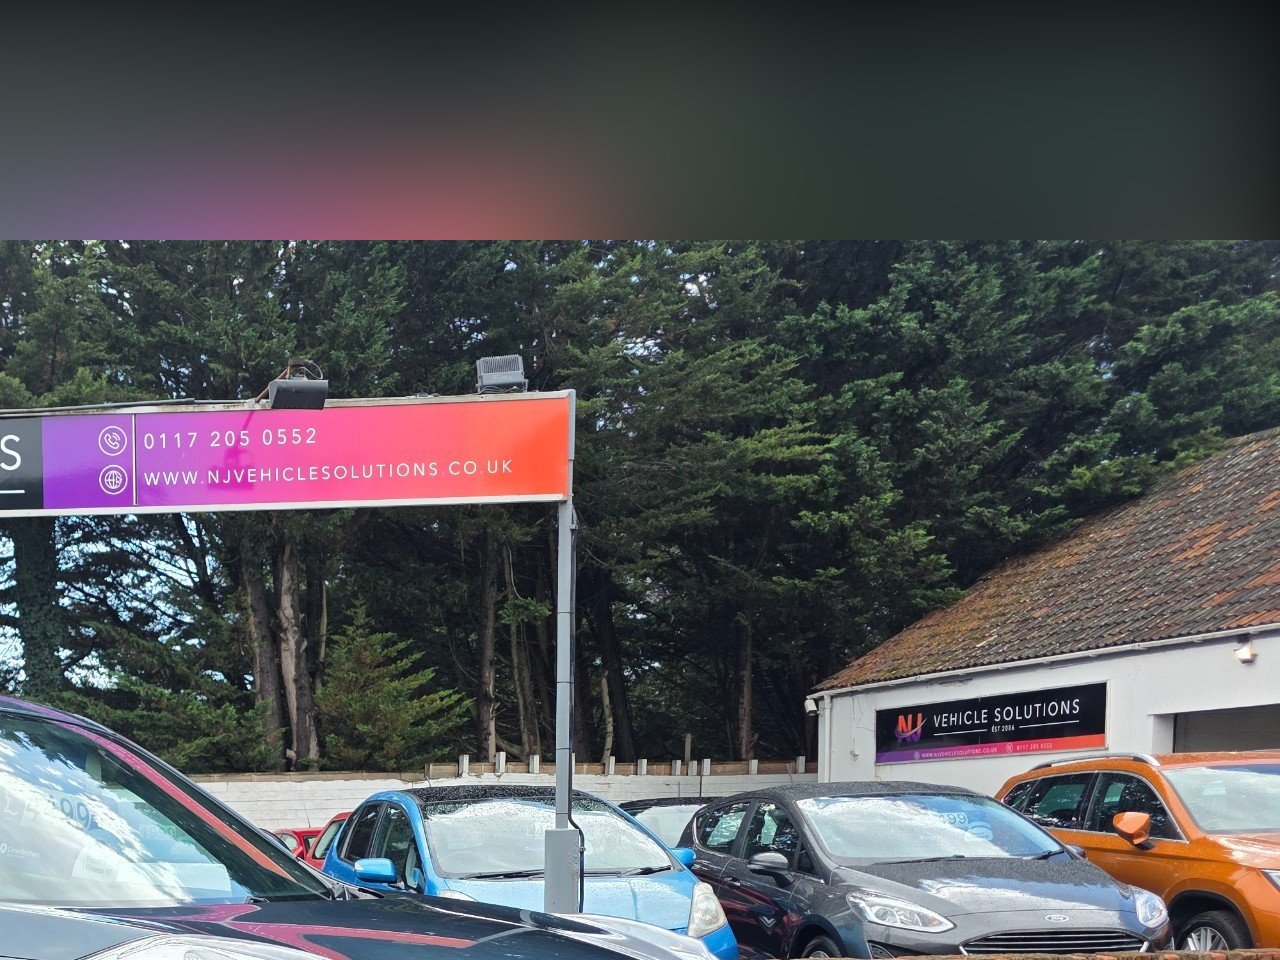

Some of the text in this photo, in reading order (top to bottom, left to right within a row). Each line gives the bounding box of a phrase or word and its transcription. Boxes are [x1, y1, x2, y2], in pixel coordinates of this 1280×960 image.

[143, 427, 317, 449] 0117 205 0552
[143, 459, 513, 486] WWW.NJVEHICLESOLUTIONS.CO.UK
[933, 698, 1080, 728] VEHICLE SOLUTIONS
